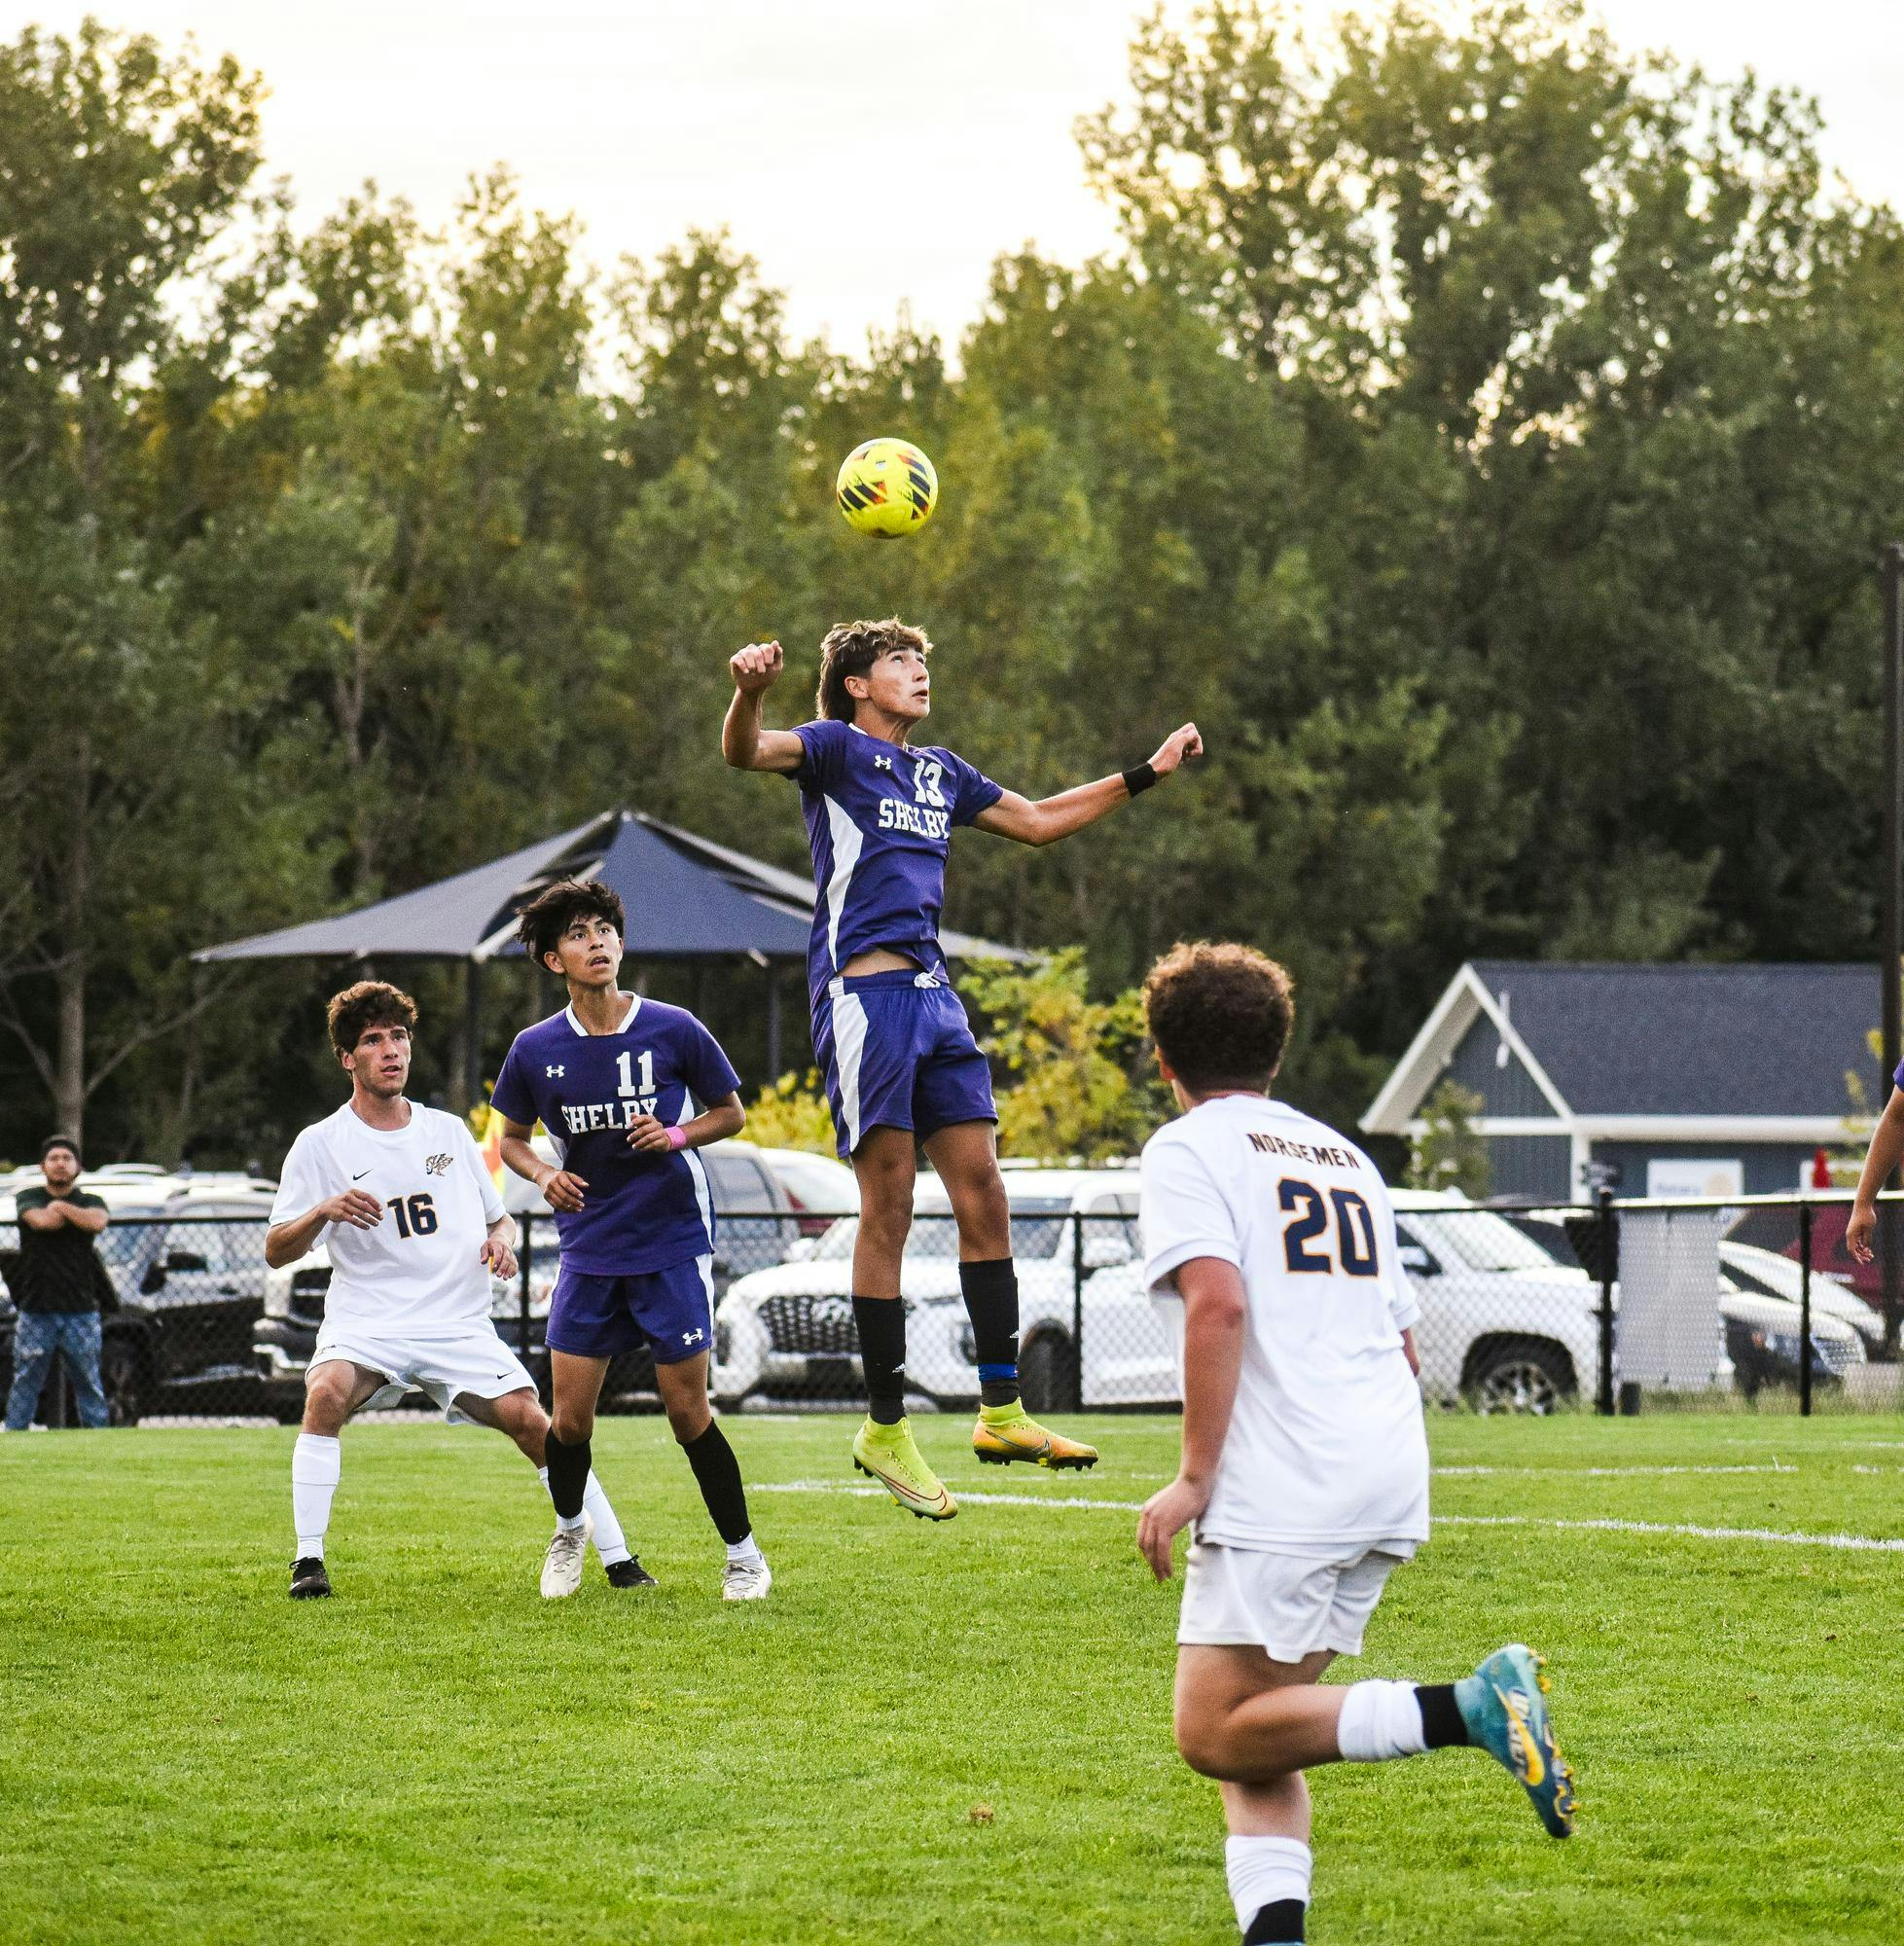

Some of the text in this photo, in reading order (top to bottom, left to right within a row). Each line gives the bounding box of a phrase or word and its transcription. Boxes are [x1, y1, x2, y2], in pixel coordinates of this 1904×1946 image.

[913, 757, 947, 808] 13
[878, 798, 950, 840] SHELBY
[616, 1050, 656, 1098] 11
[1245, 1133, 1361, 1169] NORSEMEN
[386, 1191, 439, 1240] 16
[1276, 1175, 1380, 1279] 20
